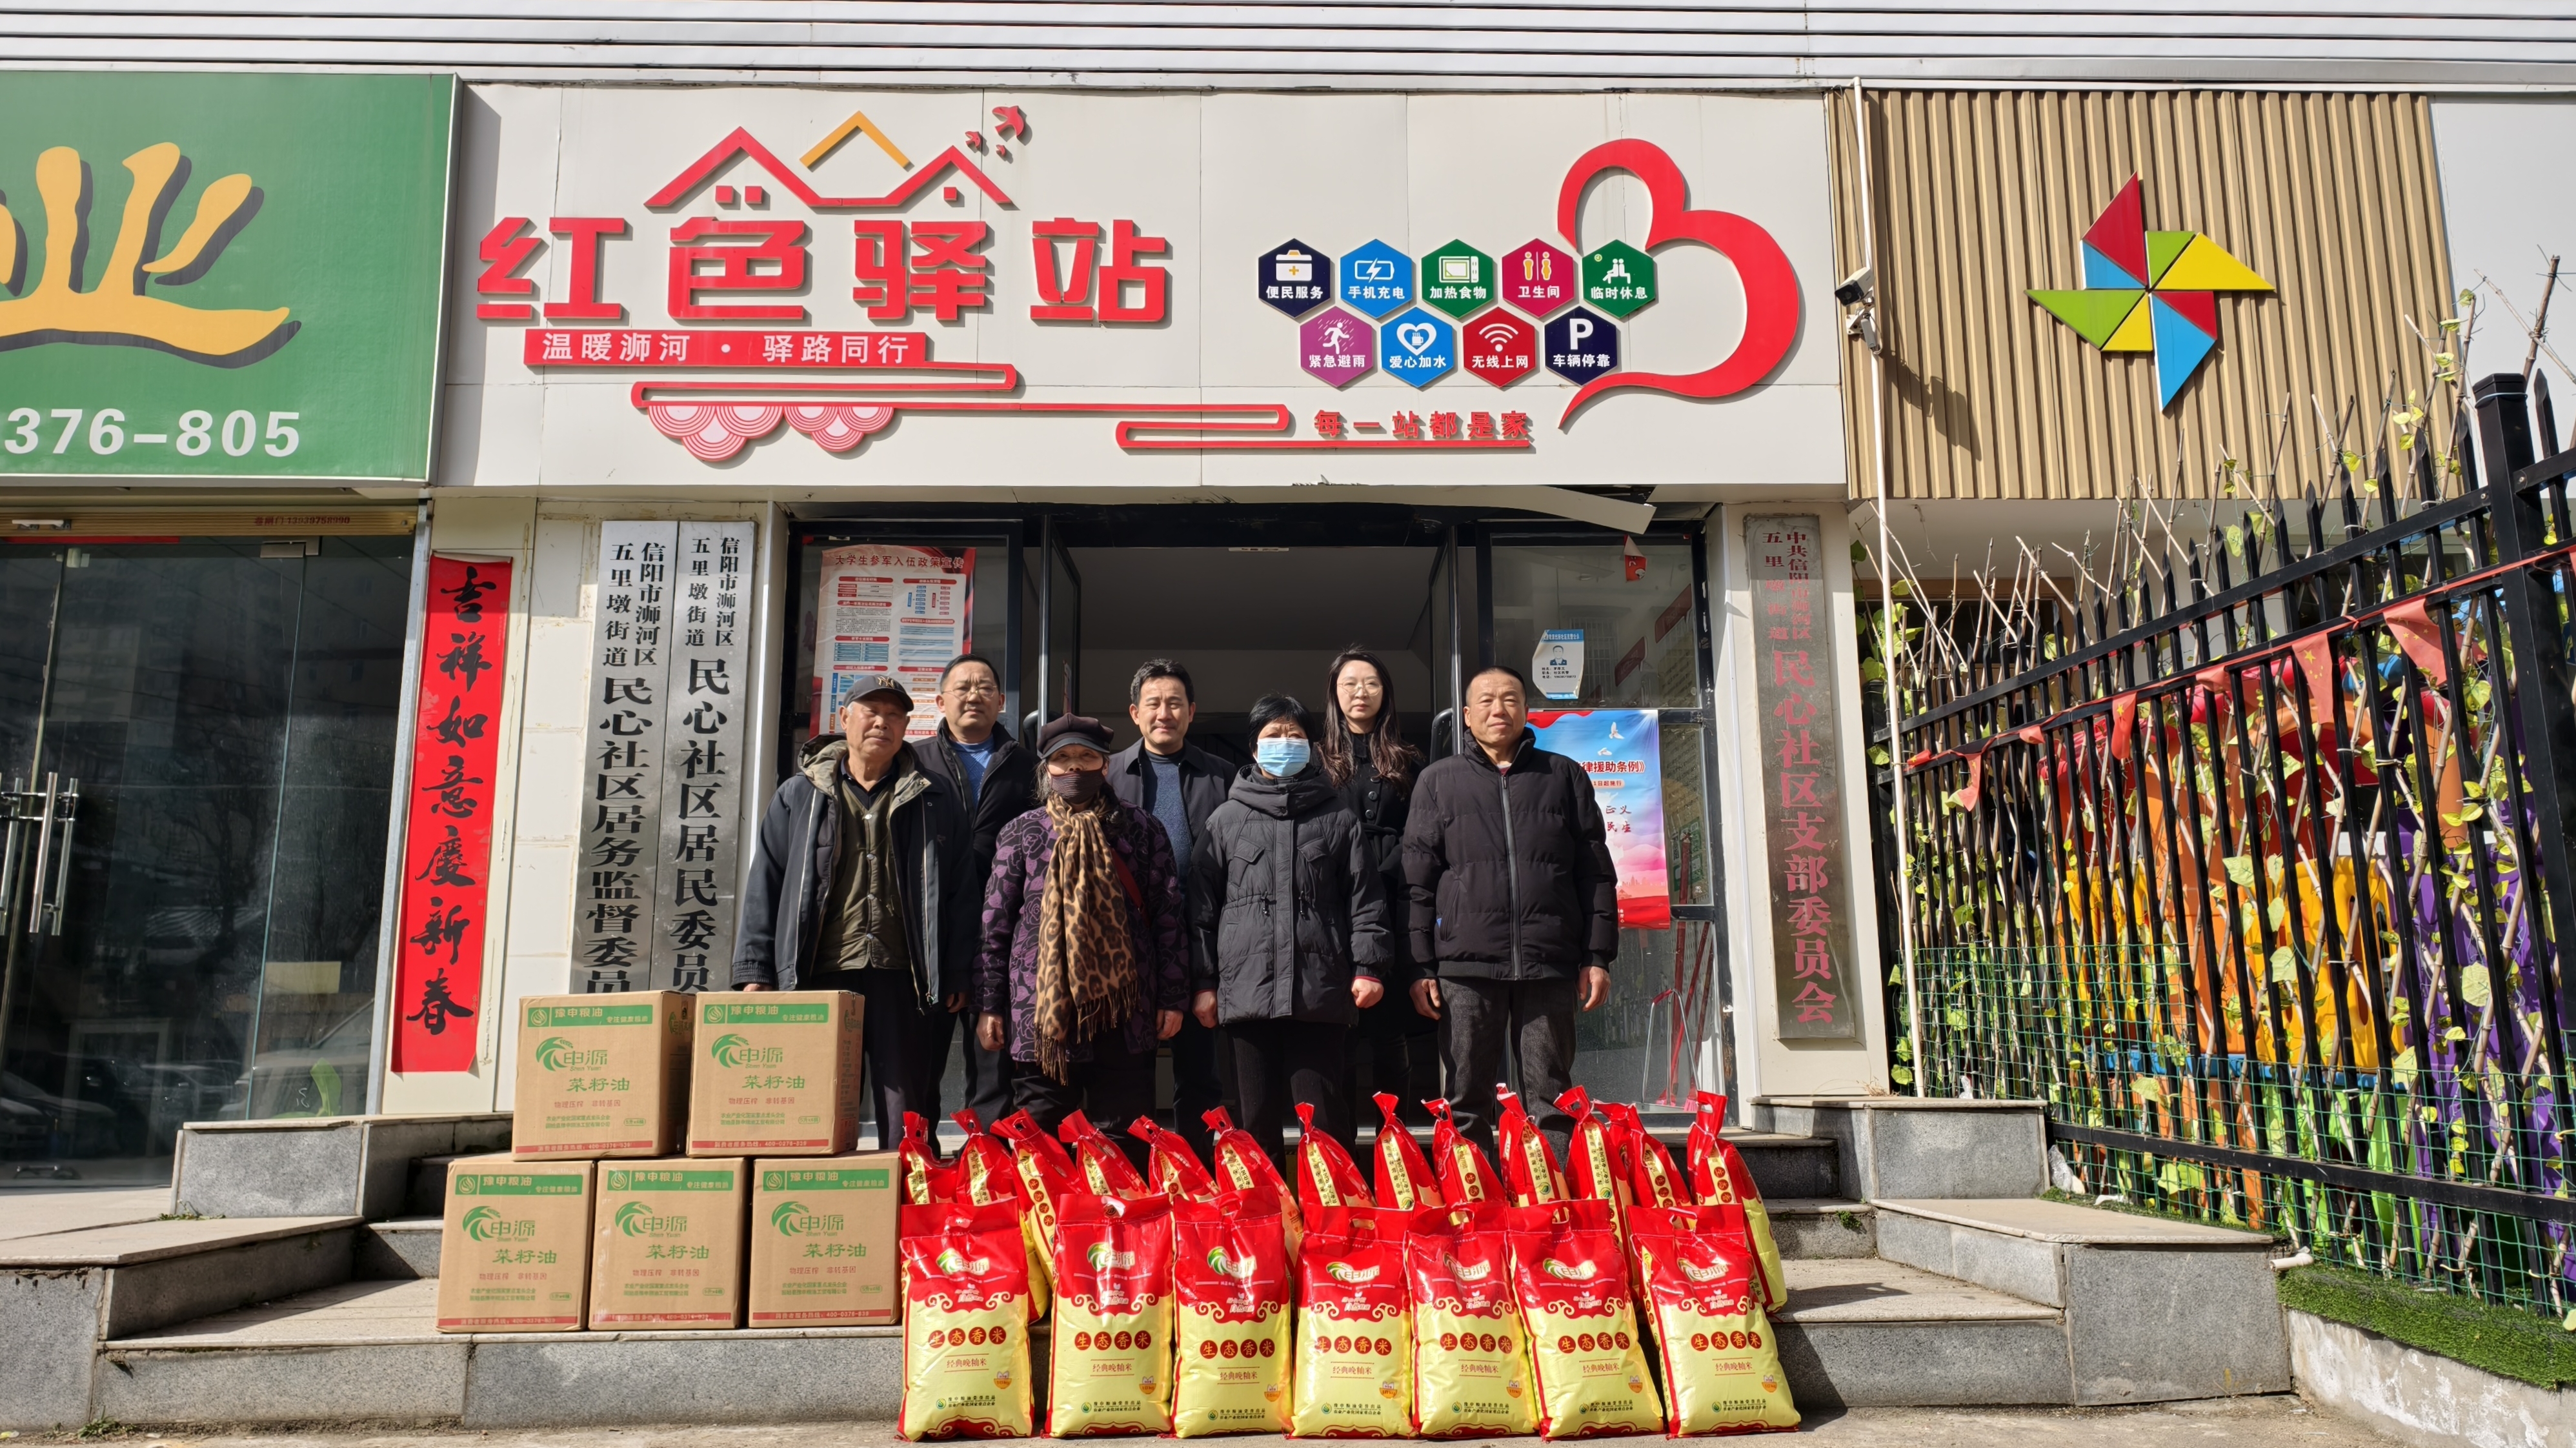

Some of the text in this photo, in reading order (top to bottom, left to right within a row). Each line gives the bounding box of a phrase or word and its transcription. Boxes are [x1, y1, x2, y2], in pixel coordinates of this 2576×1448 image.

[476, 216, 1165, 323] 红色驿站
[1266, 285, 1324, 300] 便民服务
[1347, 285, 1405, 300] 手机充电
[1429, 285, 1487, 300] 加热食物
[1517, 285, 1560, 299] 卫生间
[1590, 286, 1647, 300] 临时休息
[1569, 318, 1594, 350] P
[1309, 354, 1366, 368] 紧急避雨
[1389, 354, 1447, 369] 爱心加水
[1471, 355, 1529, 369] 无线上网
[1553, 354, 1611, 368] 车辆停靠
[1314, 409, 1529, 439] 每一站都是家
[834, 554, 965, 569] 大学生参军入伍政策宣传
[685, 537, 710, 647] 五里墩街道
[715, 537, 740, 647] 信阳市浉河区
[1762, 531, 1789, 641] 五里墩街道
[602, 543, 635, 667] 五里墩街道
[634, 542, 666, 667] 信阳市浉河区
[1607, 820, 1632, 833] 民生
[1773, 650, 1837, 1023] 民心社区支部委员会
[555, 1008, 603, 1018] 豫申粮油
[730, 1005, 778, 1016] 豫申粮油
[563, 1050, 608, 1065] 申源
[740, 1048, 783, 1063] 申源
[567, 1078, 630, 1092] 菜籽油
[742, 1075, 805, 1089] 菜籽油
[483, 1176, 532, 1186] 豫申粮油
[635, 1172, 683, 1182] 豫申粮油
[790, 1172, 838, 1182] 豫申粮油
[490, 1220, 535, 1236] 申源
[643, 1216, 687, 1232] 申源
[800, 1214, 844, 1231] 申源
[492, 1249, 557, 1264] 菜籽油
[645, 1244, 709, 1259] 菜籽油
[803, 1243, 867, 1258] 菜籽油
[1076, 1331, 1151, 1349] 生态香米
[1316, 1337, 1391, 1354] 生态香米
[1442, 1333, 1511, 1352] 生态香米
[1560, 1332, 1629, 1352] 生态香米
[1693, 1332, 1761, 1351] 生态香米
[1202, 1340, 1274, 1358] 生态香米
